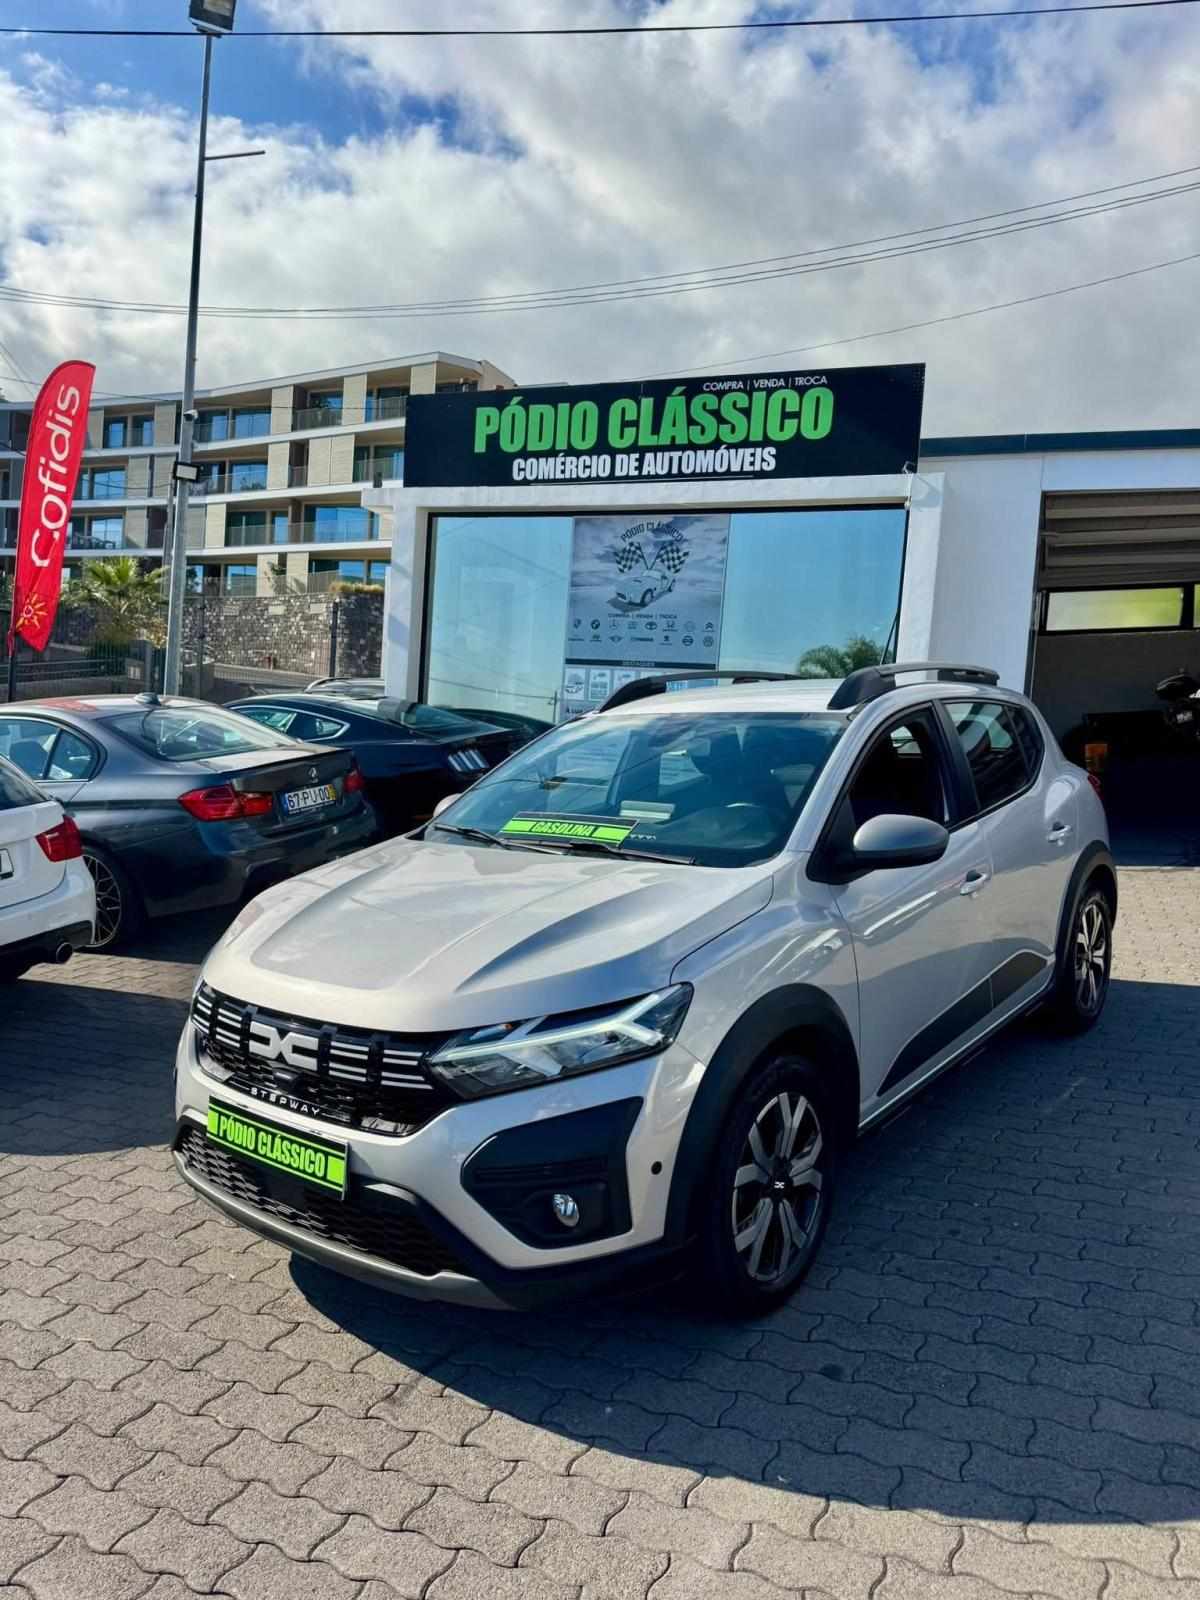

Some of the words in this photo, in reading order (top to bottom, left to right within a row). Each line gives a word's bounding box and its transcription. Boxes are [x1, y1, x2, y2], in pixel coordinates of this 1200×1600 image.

[703, 381, 744, 392] COMPRA
[753, 378, 785, 389] VENDA
[795, 375, 828, 386] TROCA
[474, 396, 599, 453] PÓDIO
[607, 386, 834, 449] CLÁSSICO
[512, 452, 611, 481] COMÉRCIO
[615, 453, 640, 477] DE
[641, 444, 777, 476] AUTOMÓVEIS
[531, 821, 594, 837] GASOLINA
[250, 1087, 320, 1117] STEPWAY
[219, 1115, 256, 1151] PÓDIO
[257, 1132, 326, 1177] CLÁSSICO
